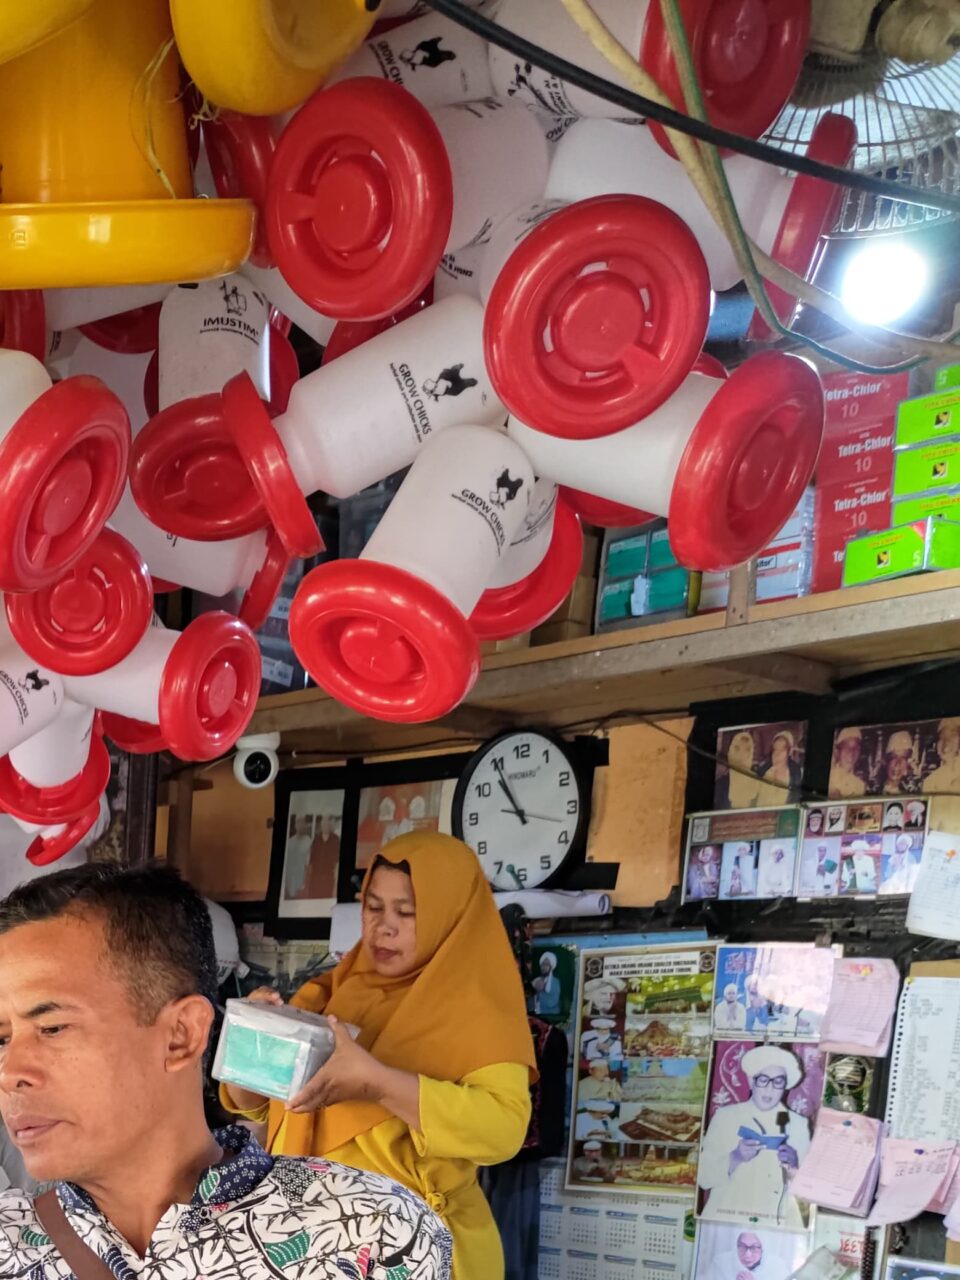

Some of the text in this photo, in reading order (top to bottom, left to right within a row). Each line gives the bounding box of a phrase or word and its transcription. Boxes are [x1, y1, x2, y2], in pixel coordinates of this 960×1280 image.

[203, 316, 257, 338] IMUSTIM
[398, 363, 432, 436] GROW CHICKS
[840, 401, 860, 419] 10
[854, 456, 872, 473] 10
[461, 488, 492, 513] GROW
[851, 510, 867, 528] 10
[512, 743, 531, 759] 12
[542, 749, 550, 764] 1
[490, 756, 504, 771] 11
[559, 771, 570, 787] 2
[475, 782, 491, 798] 10
[566, 799, 578, 815] 3
[469, 812, 479, 826] 9
[558, 830, 570, 845] 4
[477, 841, 487, 855] 8
[493, 861, 503, 875] 7
[540, 855, 552, 870] 5
[517, 868, 527, 882] 6
